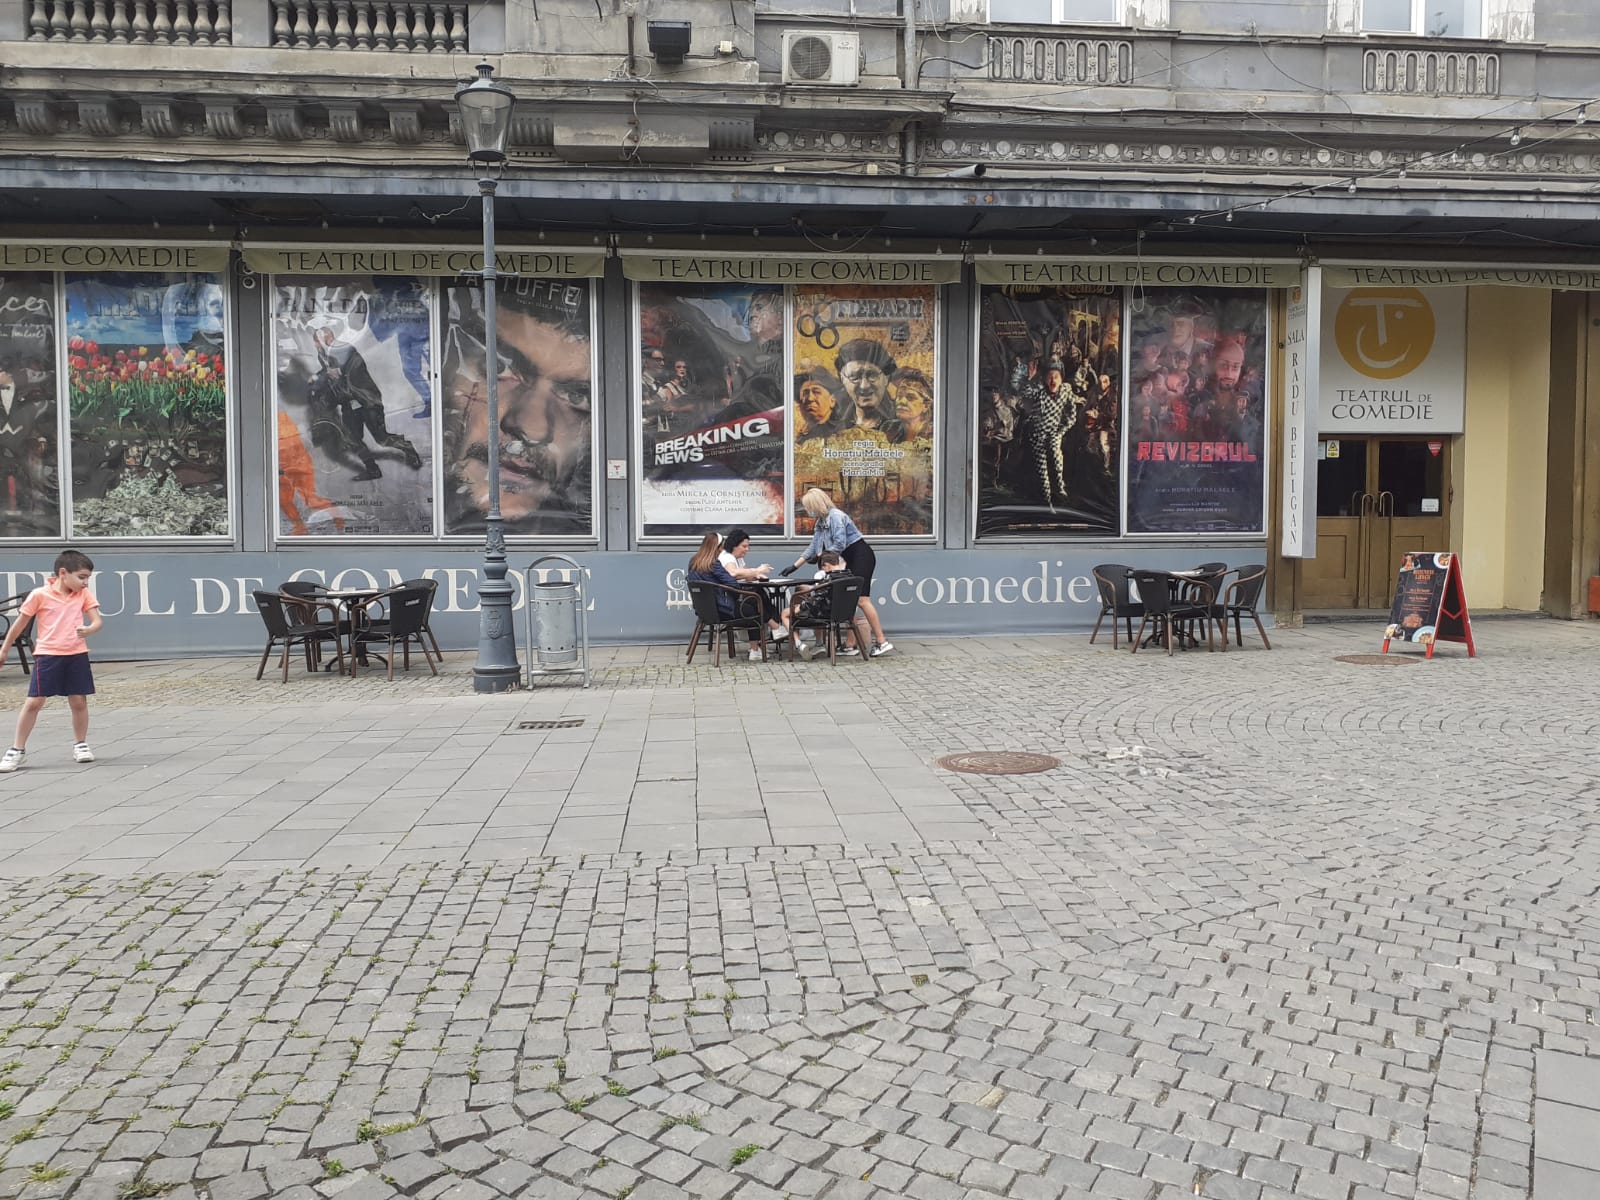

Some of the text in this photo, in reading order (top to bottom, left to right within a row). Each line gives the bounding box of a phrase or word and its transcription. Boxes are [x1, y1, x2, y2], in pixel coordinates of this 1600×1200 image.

[24, 247, 55, 265] DE
[61, 246, 198, 267] COMEDIE
[278, 252, 405, 271] TEATRUL
[412, 253, 441, 270] DE
[652, 259, 933, 281] TEATRUL DE COMEDIE
[1004, 263, 1274, 284] TEATRUL DE COMEDIE
[1348, 268, 1459, 284] TEATRUL
[1288, 328, 1305, 345] SALA
[1292, 352, 1300, 417] RADU
[1336, 390, 1433, 402] TEATRUL DE
[1331, 404, 1434, 420] COMEDIE
[655, 418, 770, 454] BREAKING
[655, 448, 704, 466] NEWS
[1136, 441, 1257, 462] REVIZORUL
[1290, 427, 1298, 545] BELIGAN
